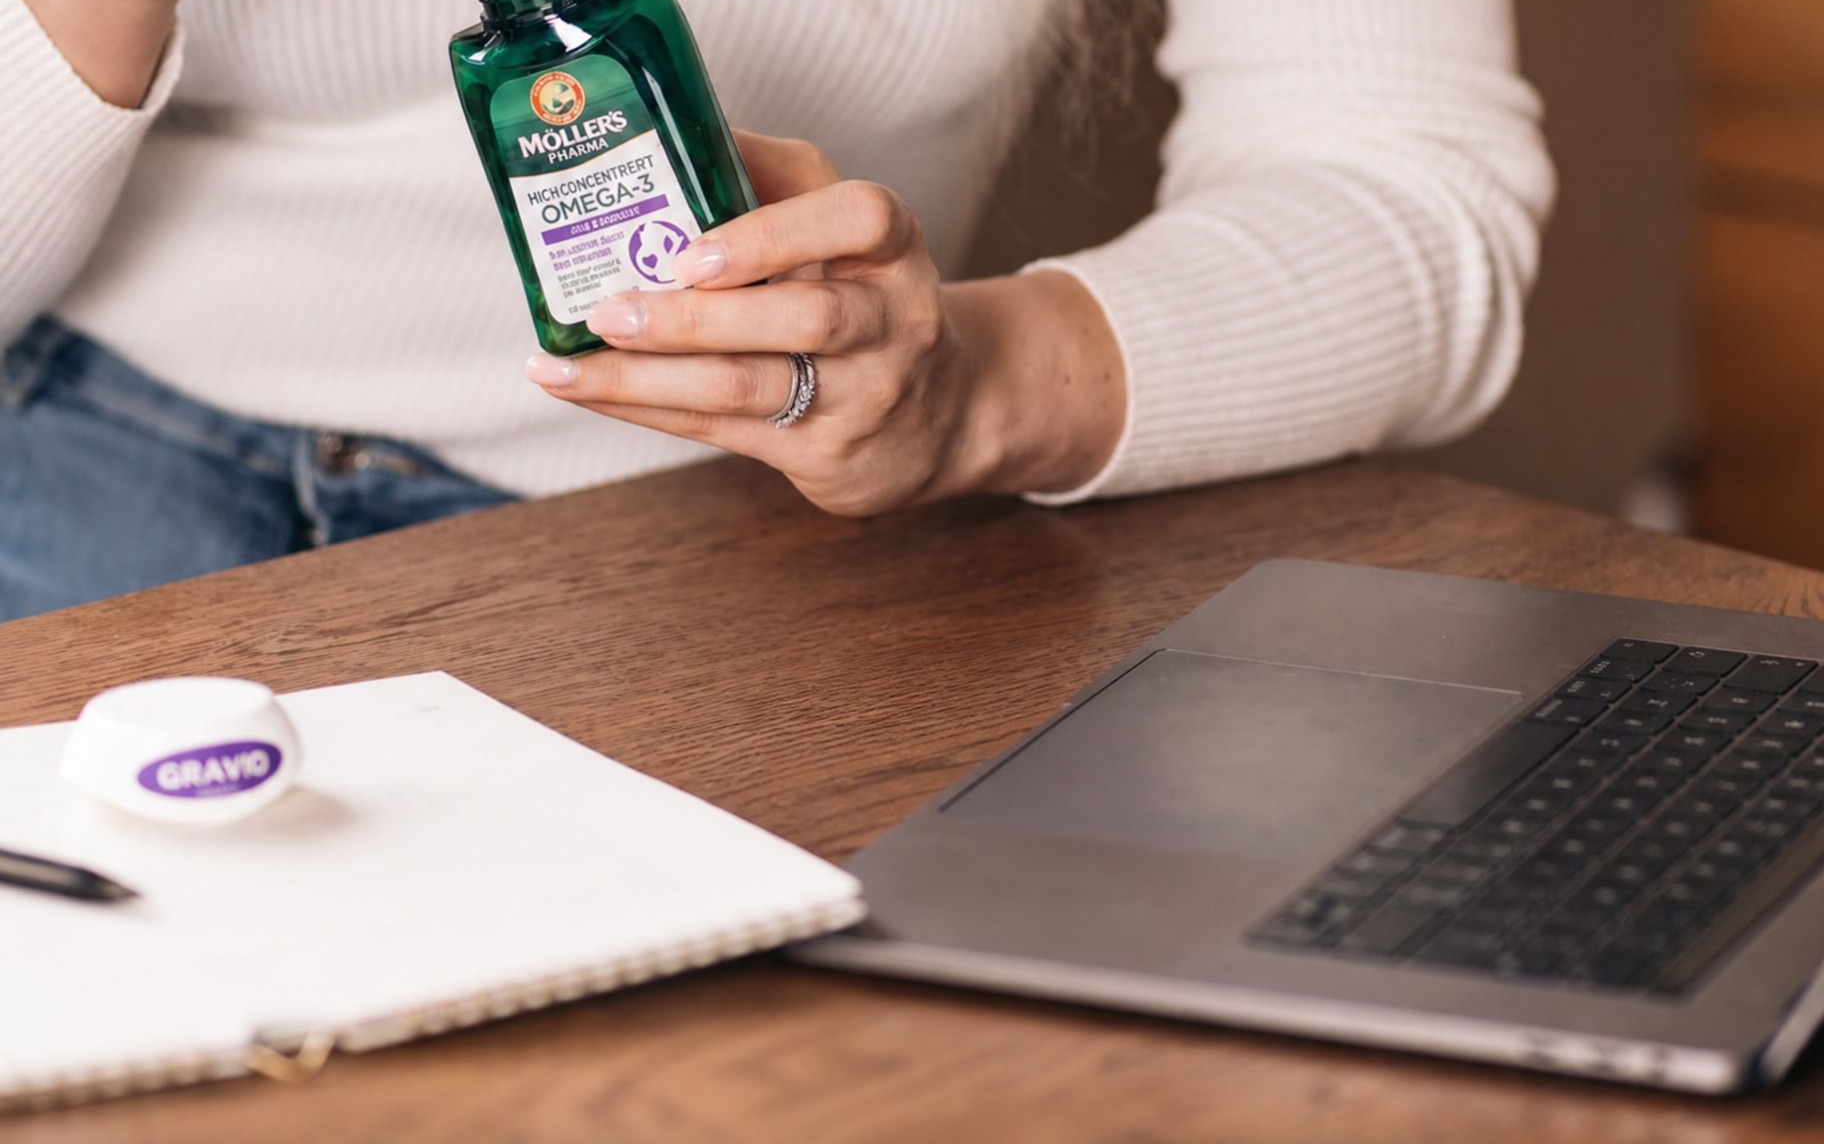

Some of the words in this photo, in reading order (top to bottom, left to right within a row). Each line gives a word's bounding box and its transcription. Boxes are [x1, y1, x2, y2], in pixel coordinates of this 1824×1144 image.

[518, 110, 628, 158] MÖLLER'S
[548, 137, 609, 164] PHARMA
[541, 173, 655, 224] OMEGA-3
